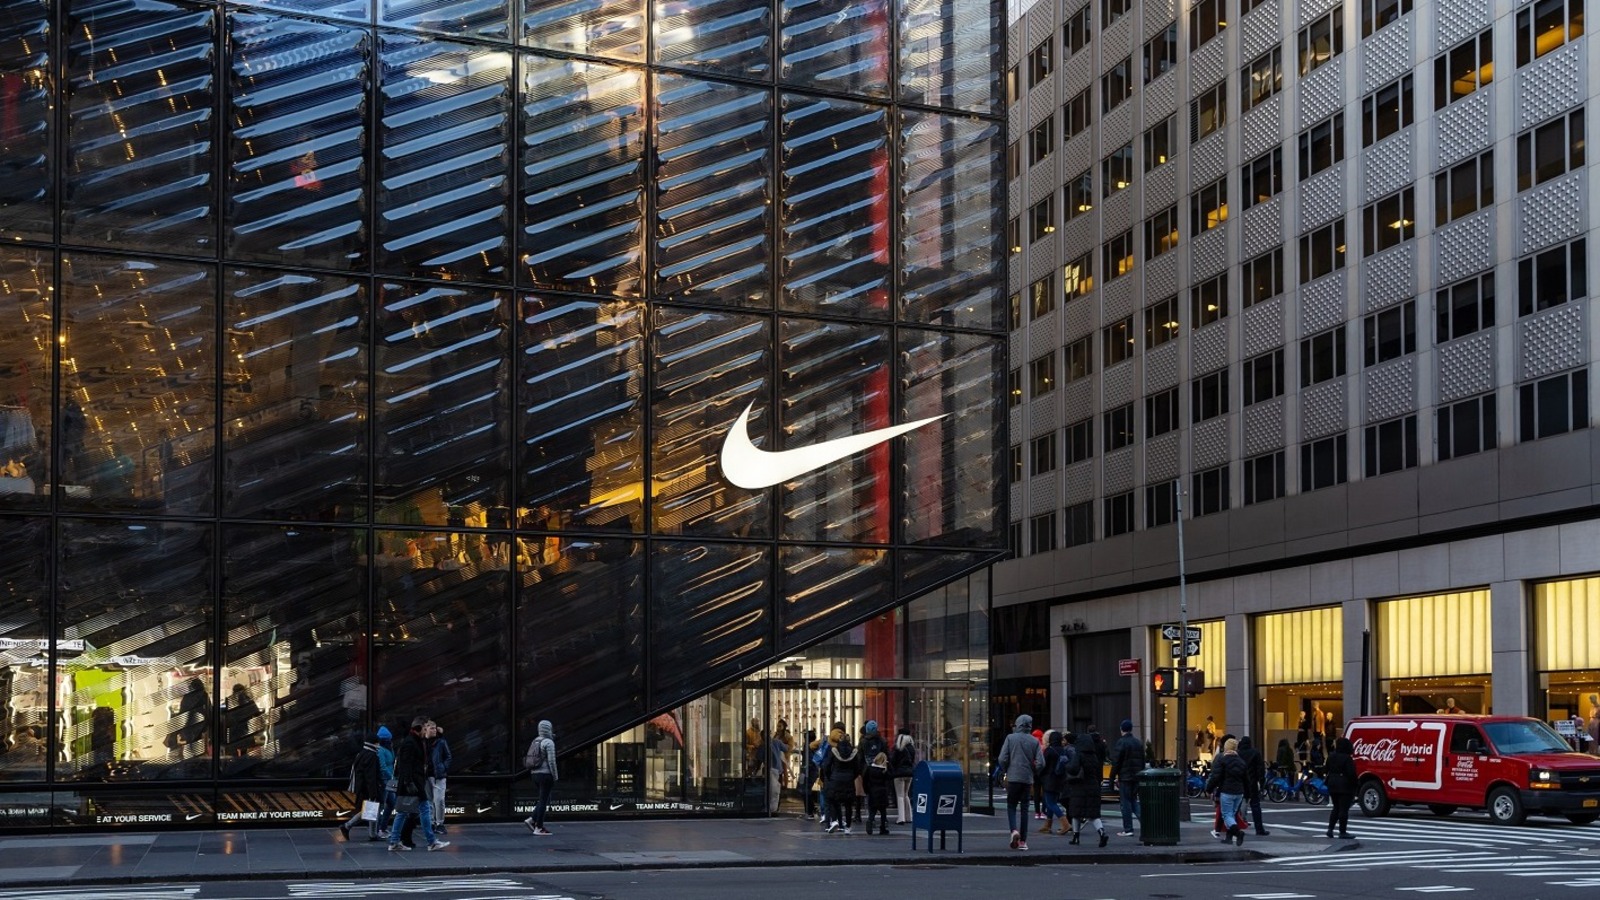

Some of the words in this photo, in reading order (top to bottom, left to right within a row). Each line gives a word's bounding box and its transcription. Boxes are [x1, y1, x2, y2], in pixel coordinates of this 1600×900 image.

[1400, 743, 1433, 756] hybrid
[550, 804, 570, 812] YOUR
[570, 803, 599, 811] SERVICE
[654, 802, 670, 810] NIKE
[102, 815, 113, 823] AT
[113, 815, 137, 823] YOUR
[138, 813, 172, 822] SERVICE
[217, 812, 239, 820] TEAM
[239, 811, 258, 819] NIKE
[258, 811, 268, 819] AT
[269, 811, 292, 819] YOUR
[292, 810, 323, 818] SERVICE
